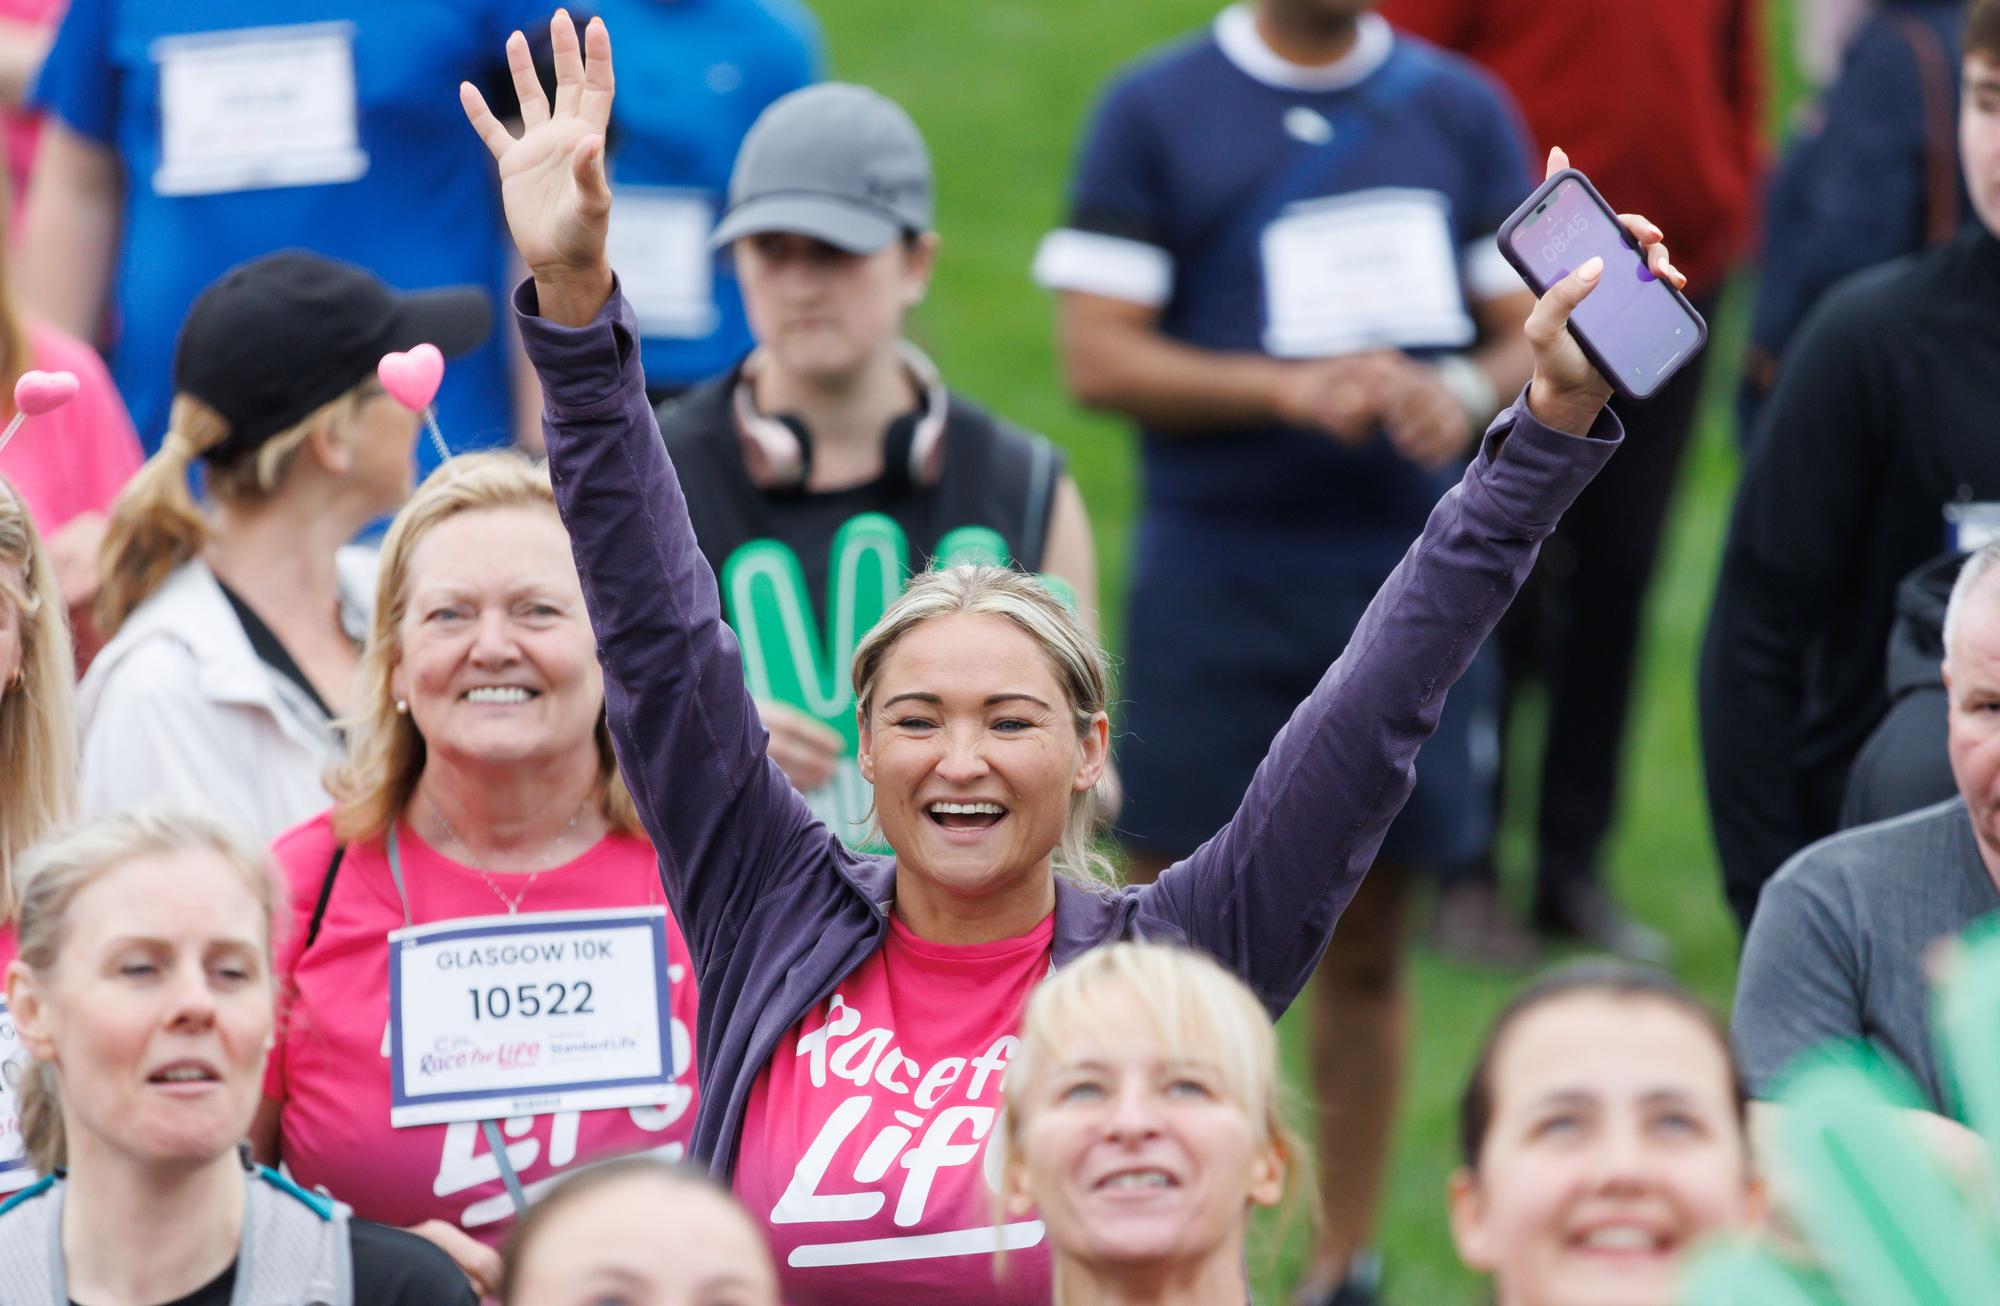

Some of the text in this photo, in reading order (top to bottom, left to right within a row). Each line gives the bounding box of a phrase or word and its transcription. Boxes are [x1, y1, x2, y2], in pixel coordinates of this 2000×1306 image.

[1543, 213, 1588, 261] 08:45
[436, 941, 613, 971] GLASGOW 10K
[468, 981, 595, 1022] 10522
[419, 1050, 467, 1076] Race
[471, 1047, 495, 1067] for
[498, 1039, 541, 1066] Life
[796, 994, 967, 1109] Race
